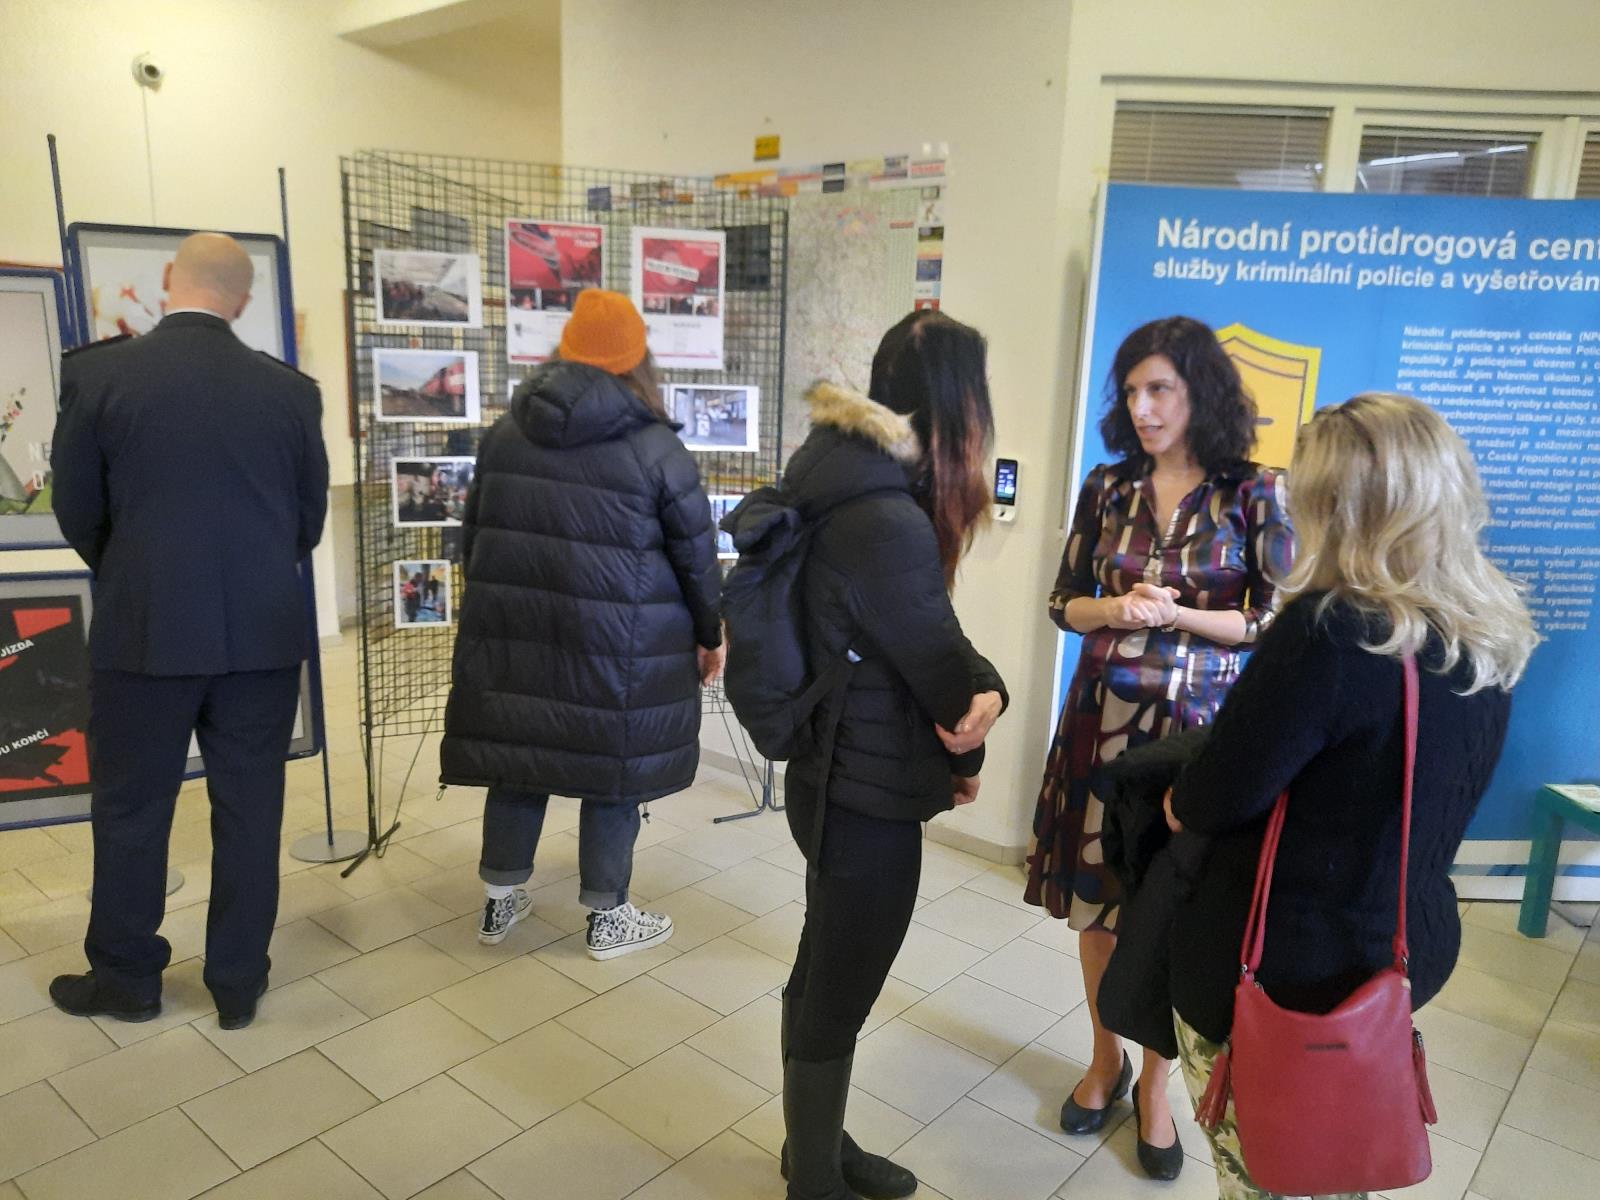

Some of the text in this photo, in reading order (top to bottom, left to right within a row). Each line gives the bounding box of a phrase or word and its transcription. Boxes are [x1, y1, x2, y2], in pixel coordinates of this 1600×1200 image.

[1157, 217, 1291, 251] Národní
[1299, 225, 1517, 264] protidrogová
[1153, 257, 1229, 285] služby
[1236, 260, 1352, 285] kriminální
[1356, 265, 1434, 289] policie
[1440, 271, 1454, 288] a
[1420, 383, 1473, 393] odhalovat
